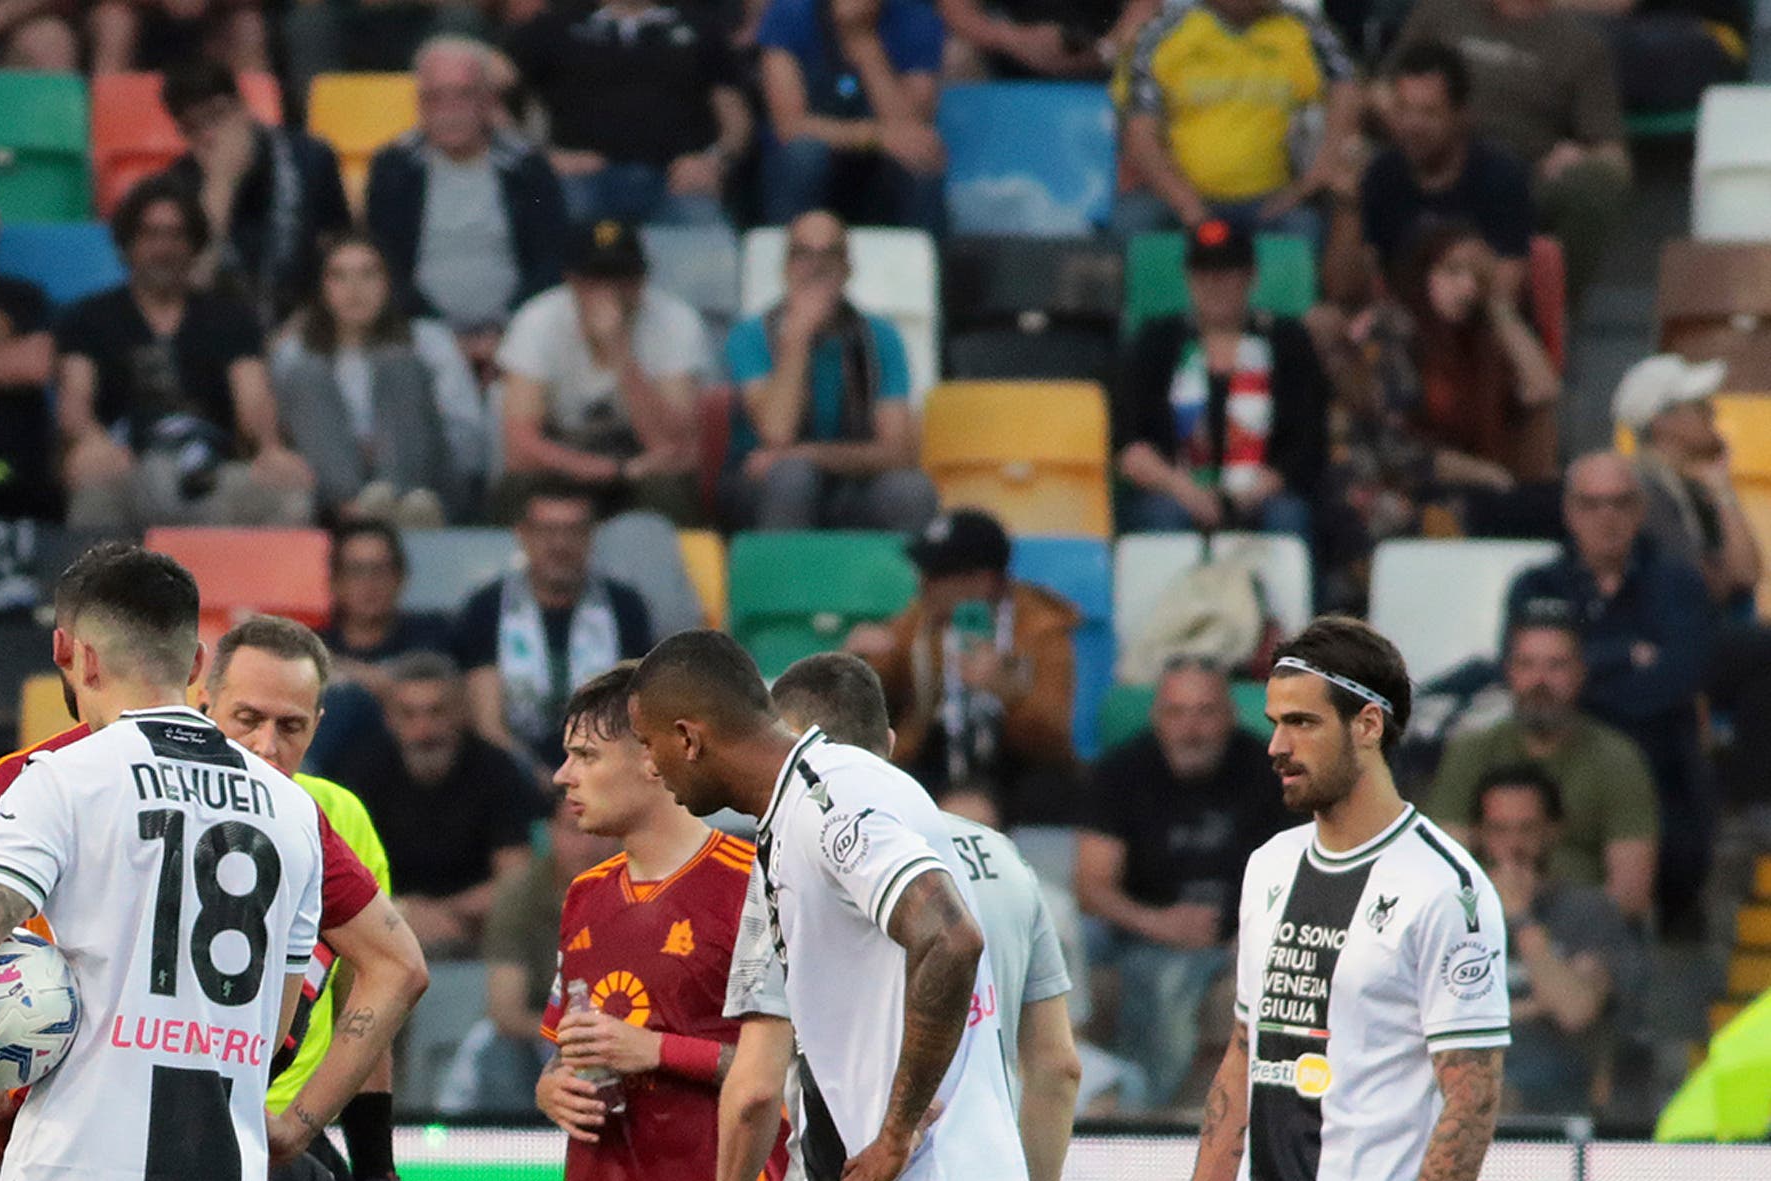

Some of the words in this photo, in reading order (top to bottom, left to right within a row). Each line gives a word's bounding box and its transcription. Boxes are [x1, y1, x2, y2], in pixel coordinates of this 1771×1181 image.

[951, 835, 999, 882] SE
[137, 808, 282, 1007] 18
[1273, 921, 1295, 943] IO
[1297, 924, 1347, 950] SONO
[1266, 945, 1317, 971] FRIULI
[1262, 970, 1328, 999] VENEZIA
[1258, 997, 1317, 1024] GIULIA
